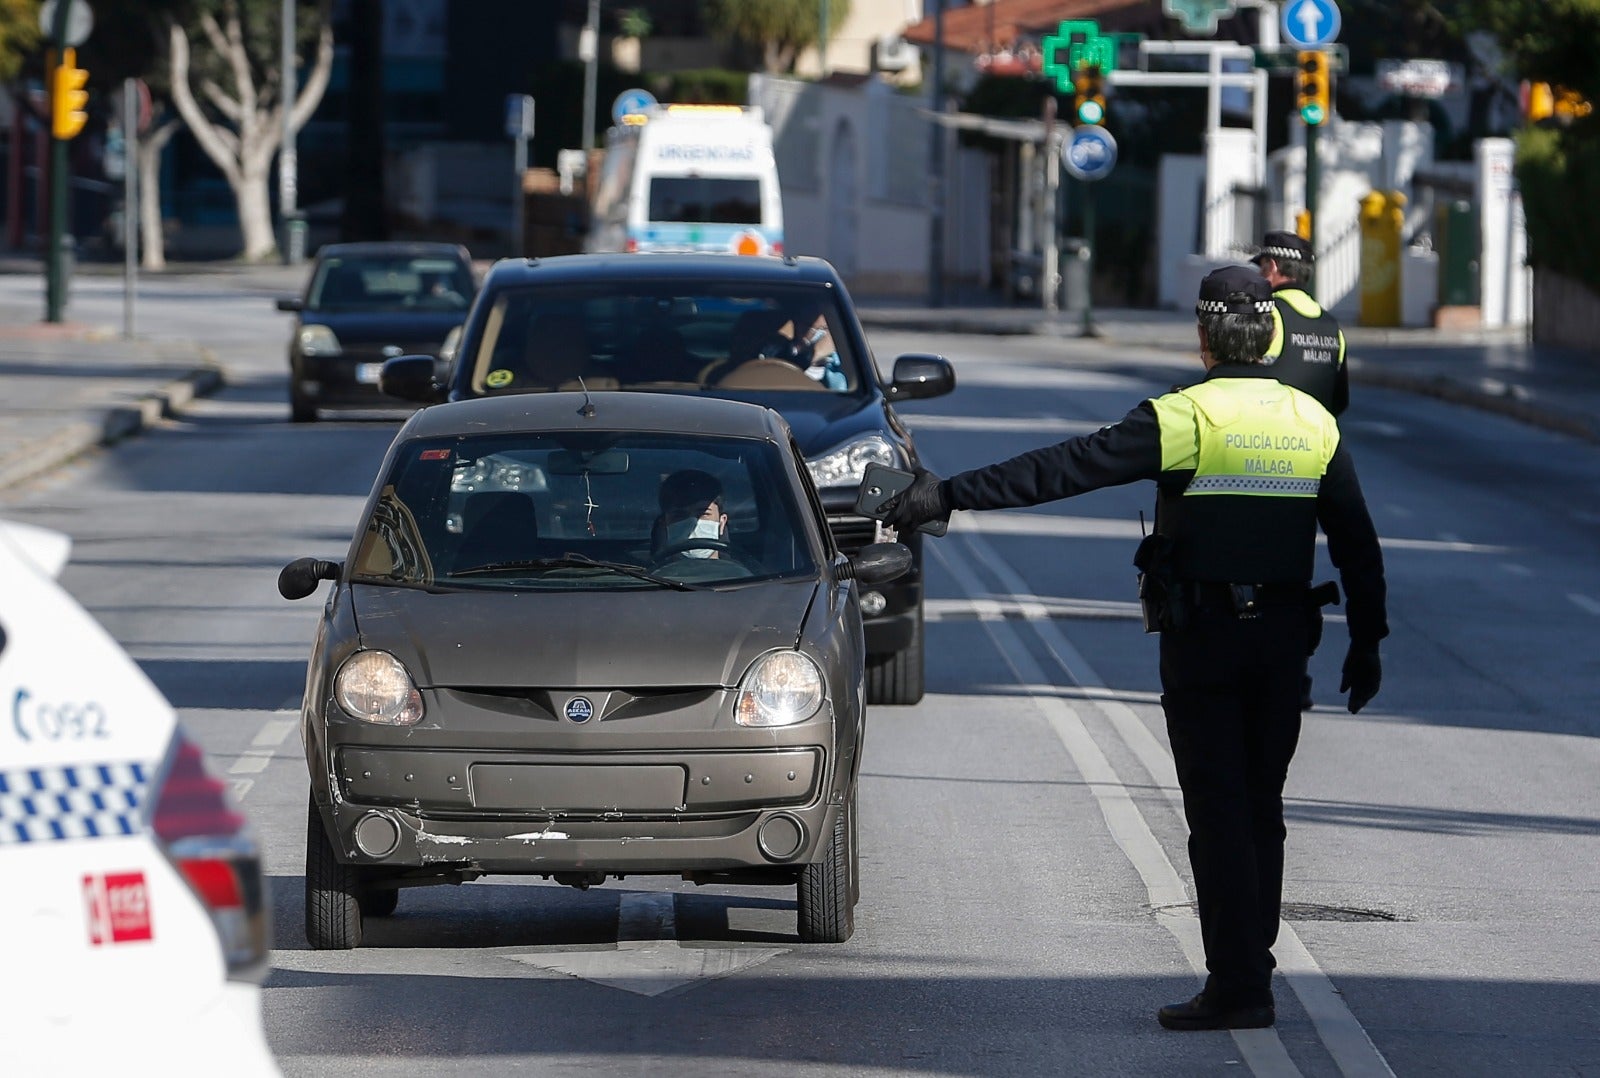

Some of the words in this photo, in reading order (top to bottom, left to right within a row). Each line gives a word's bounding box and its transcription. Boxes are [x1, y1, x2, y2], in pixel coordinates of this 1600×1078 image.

[1303, 348, 1331, 362] MÁLAGA
[1225, 432, 1272, 449] POLICÍA
[1275, 436, 1311, 451] LOCAL
[1245, 455, 1293, 474] MÁLAGA
[37, 702, 112, 740] 092
